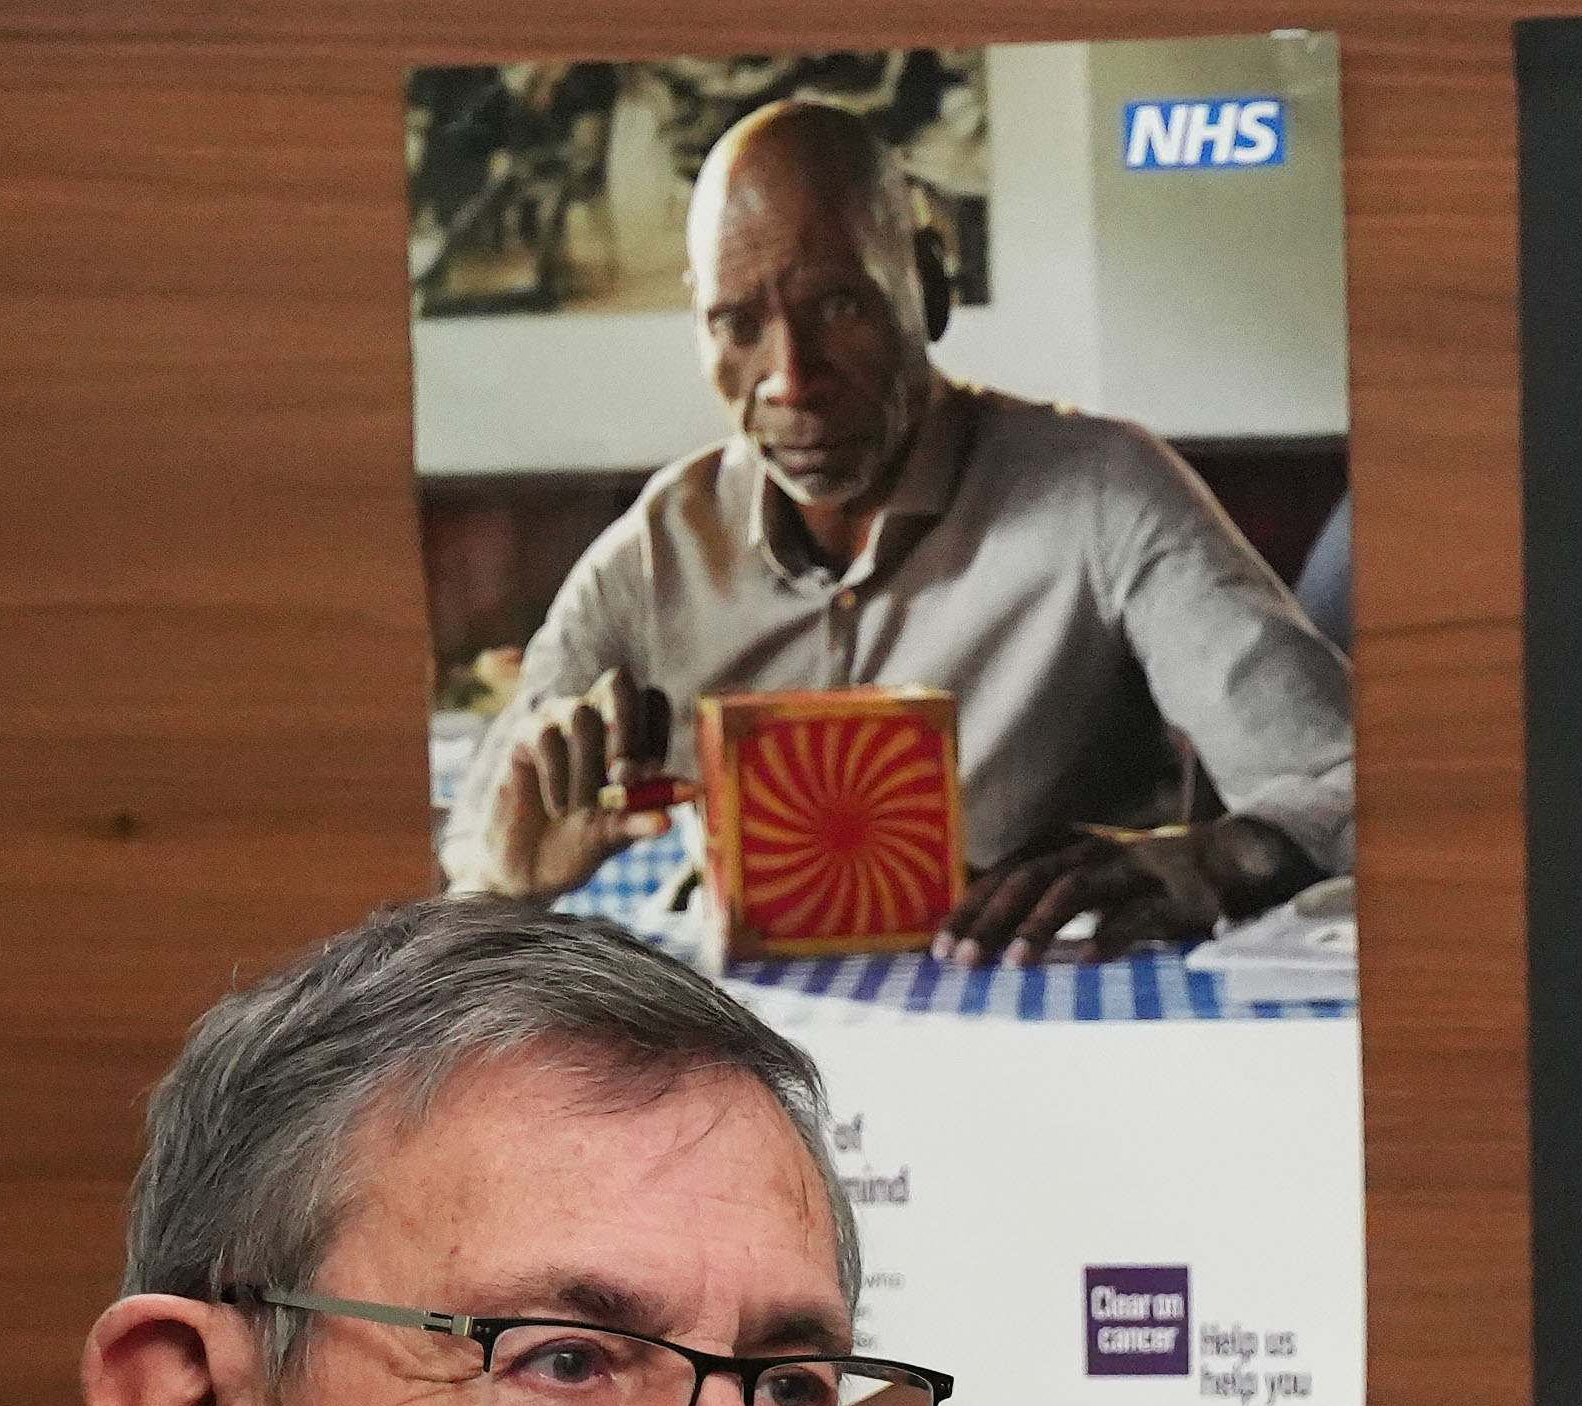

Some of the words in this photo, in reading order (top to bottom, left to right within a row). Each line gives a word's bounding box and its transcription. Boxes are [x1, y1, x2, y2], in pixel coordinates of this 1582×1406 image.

[1126, 100, 1279, 167] NHS
[1090, 1285, 1151, 1322] Clear
[1152, 1292, 1186, 1322] on
[1097, 1325, 1180, 1355] cancer
[1200, 1322, 1259, 1363] Help
[1265, 1330, 1298, 1356] us
[1200, 1364, 1259, 1406] help
